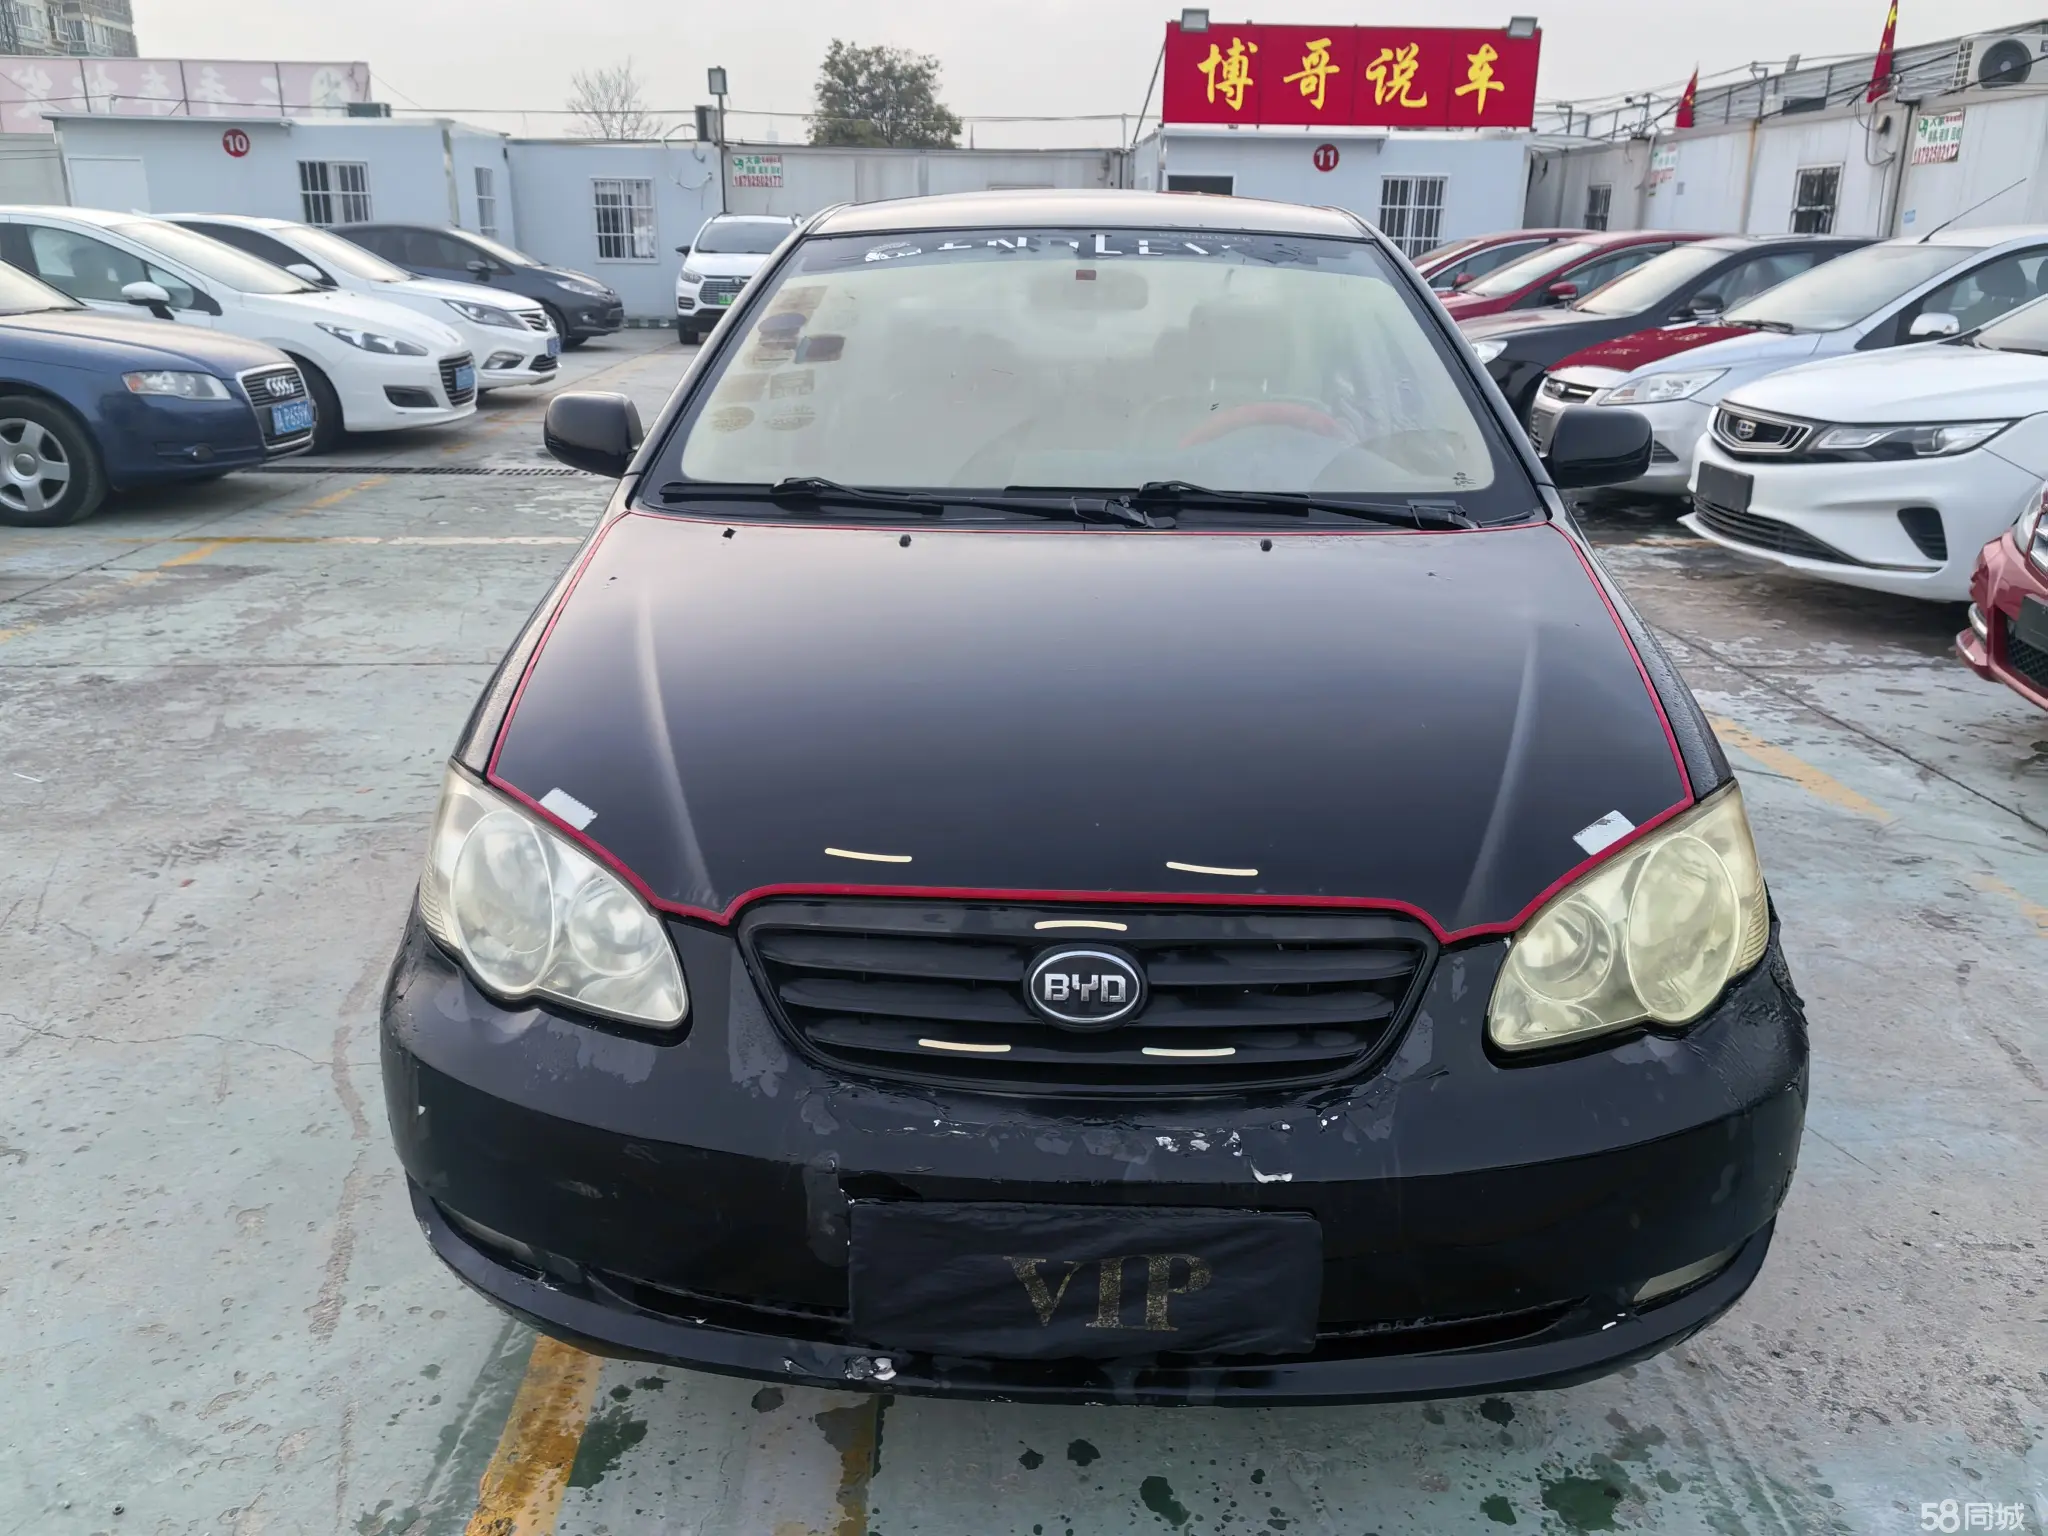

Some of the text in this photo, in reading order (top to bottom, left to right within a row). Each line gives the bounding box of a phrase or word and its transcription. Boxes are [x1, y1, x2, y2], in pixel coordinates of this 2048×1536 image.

[1197, 37, 1505, 115] 博哥说车
[225, 134, 248, 152] 10
[1316, 149, 1335, 167] 11
[1044, 973, 1127, 1003] BYD
[1002, 1253, 1212, 1331] VIP
